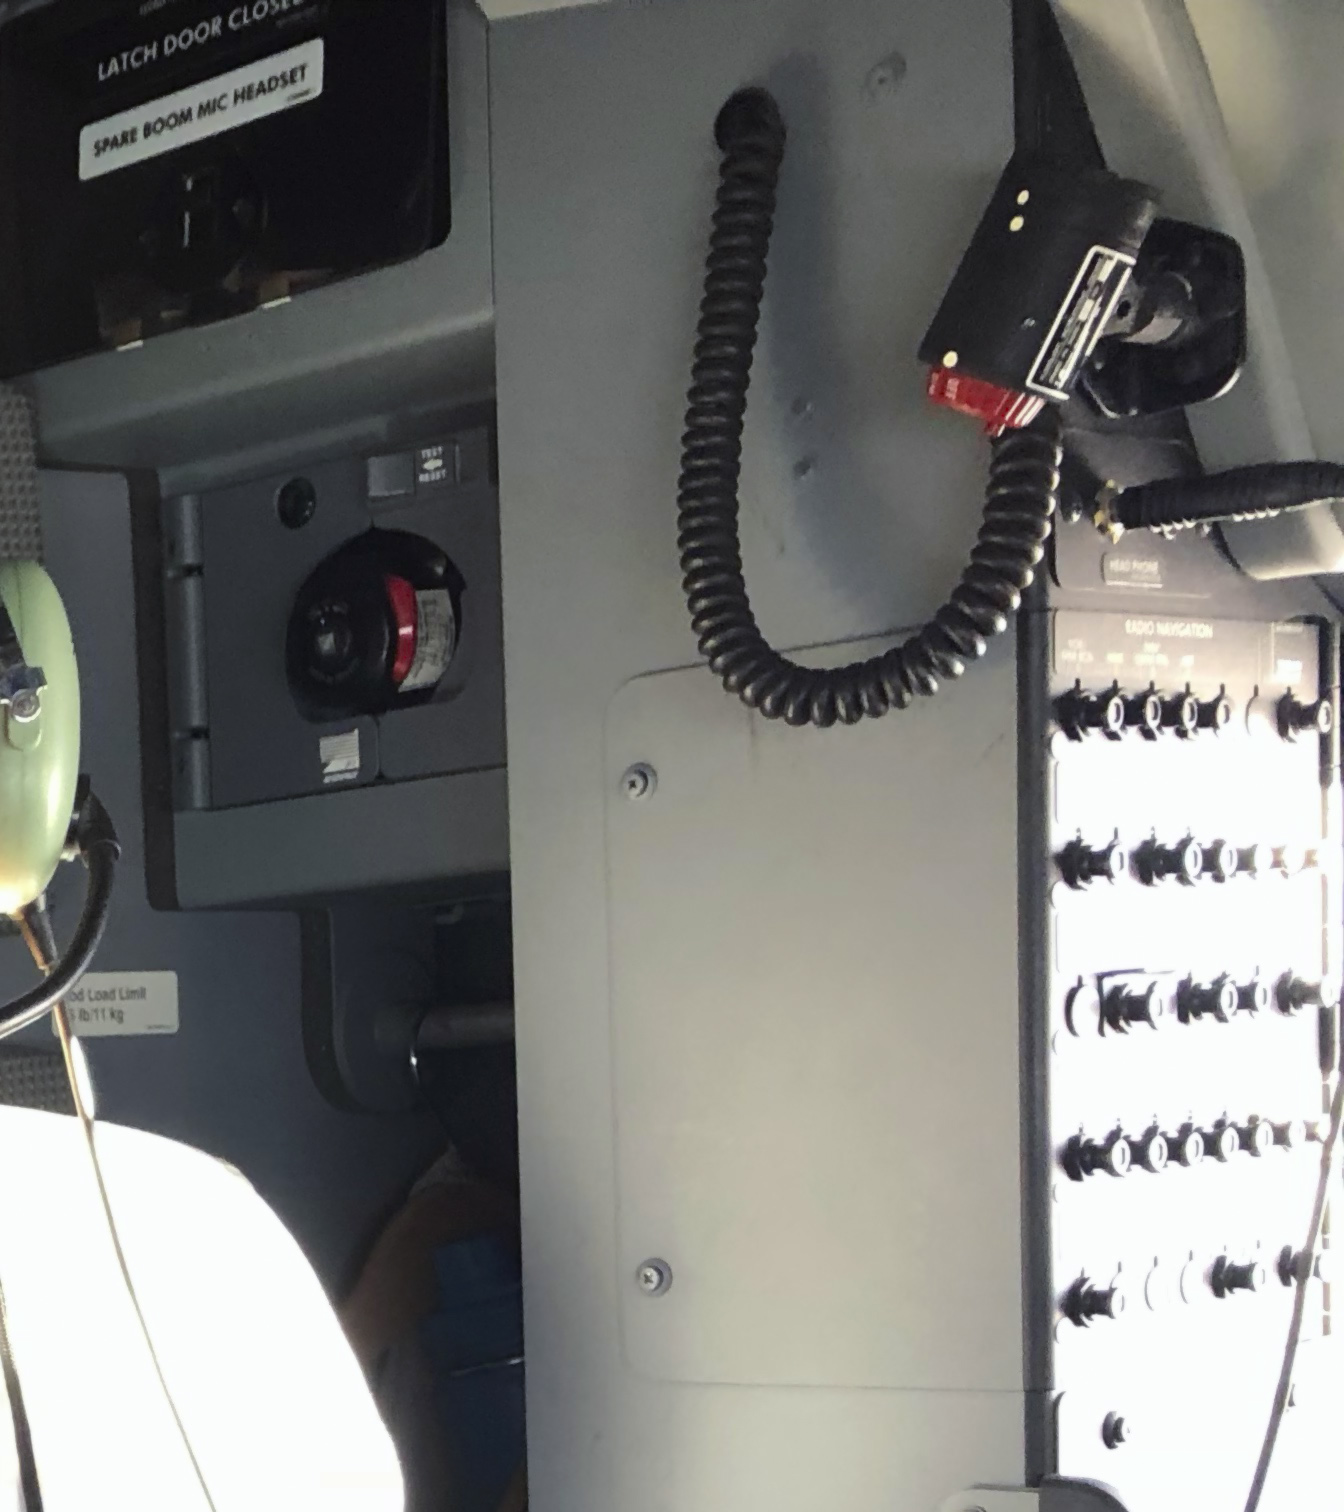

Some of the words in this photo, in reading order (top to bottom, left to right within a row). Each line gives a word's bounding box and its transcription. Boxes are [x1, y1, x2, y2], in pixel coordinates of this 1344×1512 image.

[98, 41, 158, 81] LATCH
[164, 16, 223, 56] DOOR
[228, 0, 303, 31] CLOSE
[94, 127, 138, 158] SPARE
[143, 107, 193, 140] BOOM
[197, 93, 228, 120] MIC
[233, 63, 308, 107] HEADSET
